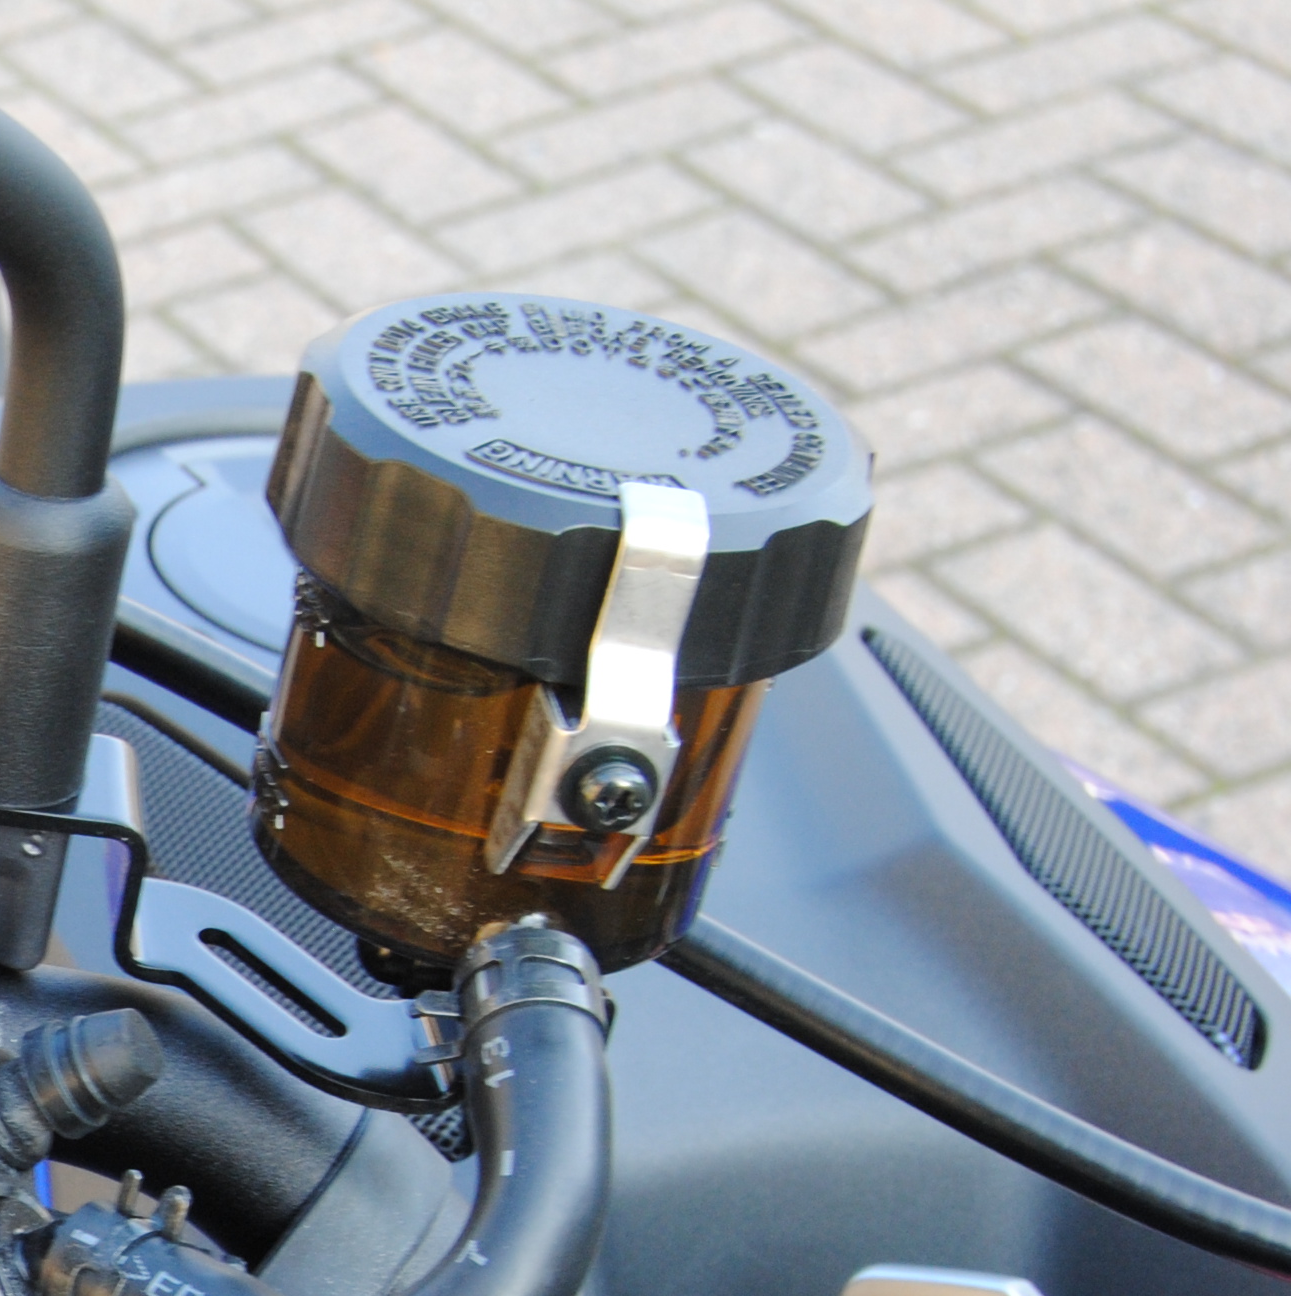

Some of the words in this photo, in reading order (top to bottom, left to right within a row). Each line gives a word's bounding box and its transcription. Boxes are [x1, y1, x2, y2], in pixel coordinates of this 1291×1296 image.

[419, 302, 510, 328] BRAKE
[627, 320, 712, 354] FROM
[368, 352, 406, 392] ONLY
[716, 356, 740, 369] A
[387, 397, 441, 428] USE
[409, 373, 471, 425] CLEAN
[745, 373, 819, 430] SEALED
[734, 432, 823, 496] CONTAINER
